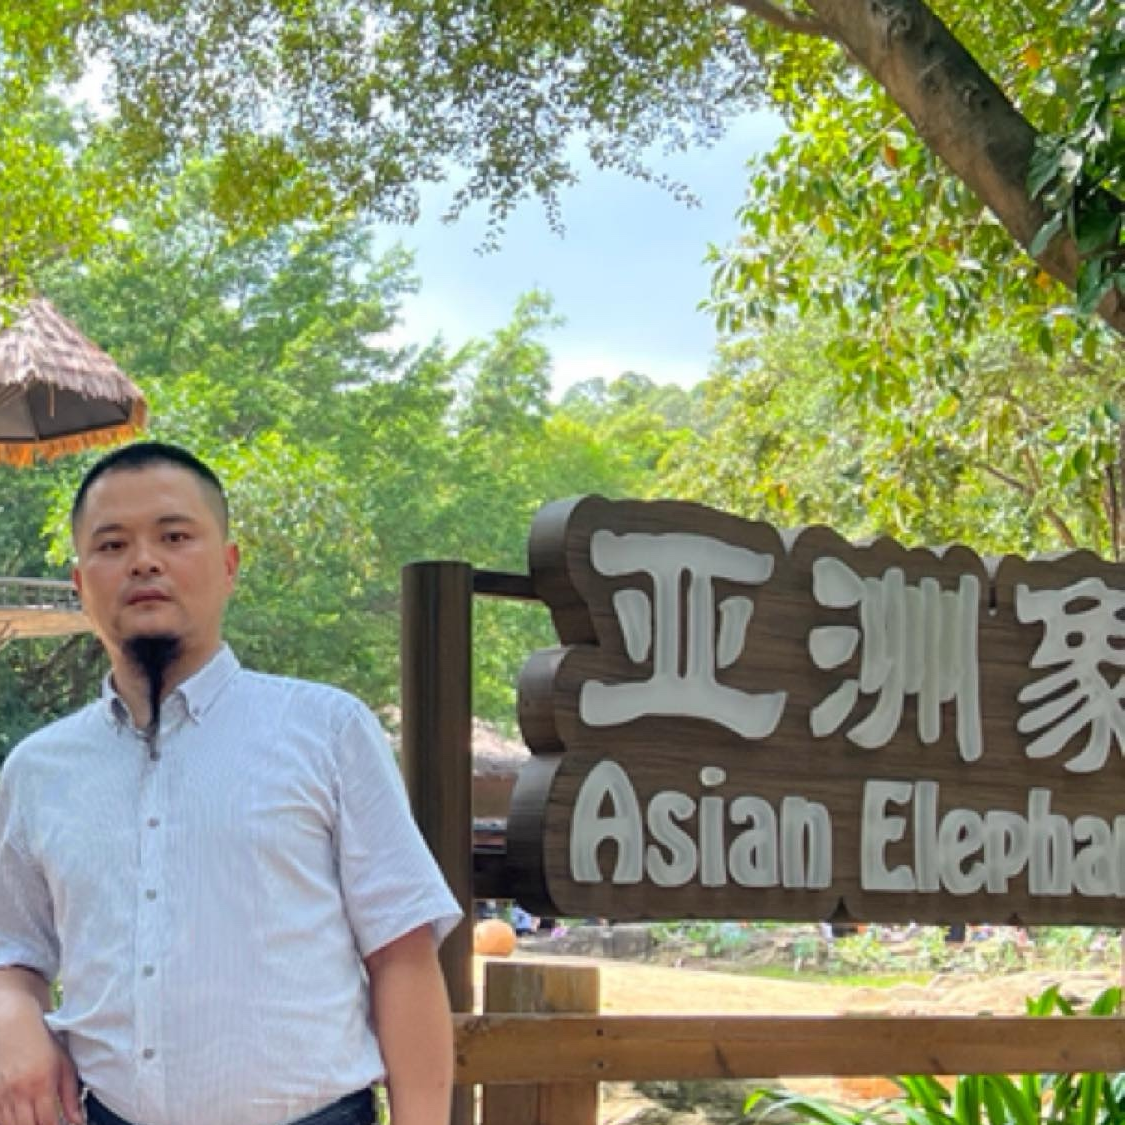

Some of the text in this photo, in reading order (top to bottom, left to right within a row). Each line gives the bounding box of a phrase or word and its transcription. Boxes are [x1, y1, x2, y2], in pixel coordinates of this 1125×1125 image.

[580, 529, 1125, 773] 亚洲象
[570, 760, 1125, 898] Asian Elepha
